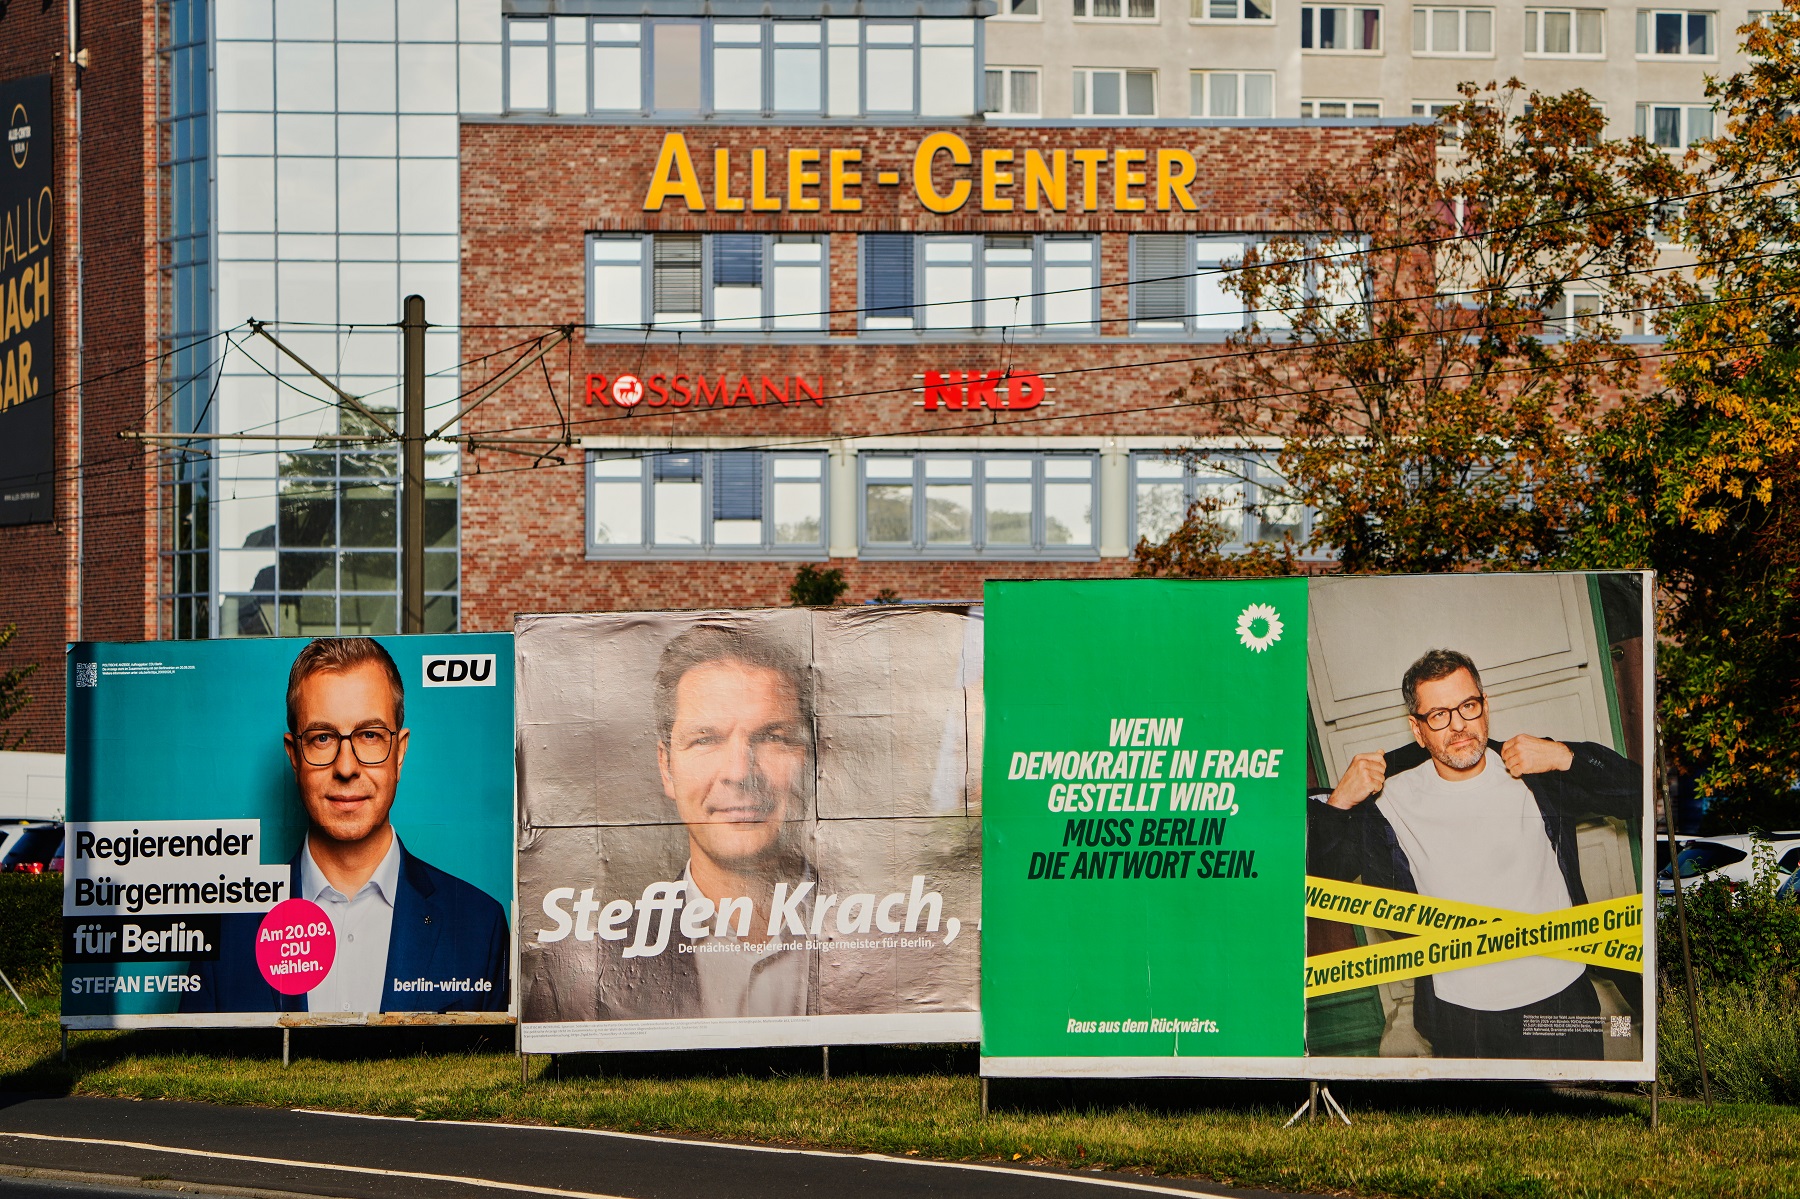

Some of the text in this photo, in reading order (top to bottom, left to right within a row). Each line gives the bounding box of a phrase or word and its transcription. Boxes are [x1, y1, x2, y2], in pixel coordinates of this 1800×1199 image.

[0, 186, 53, 273] ALLO
[0, 340, 39, 413] AR.
[924, 370, 1046, 412] NKD
[426, 659, 492, 682] CDU
[1108, 718, 1184, 747] WENN
[1008, 749, 1284, 780] DEMOKRATIE IN FRAGE
[1048, 782, 1240, 816] GESTELLT WIRD,
[76, 828, 254, 866] Regierender
[1063, 818, 1226, 847] MUSS BERLIN
[1027, 850, 1258, 880] DIE ANTWORT SEIN.
[74, 874, 284, 912] Bürgermeister
[1306, 886, 1372, 916] Werner
[1372, 898, 1417, 922] Graf
[537, 875, 961, 958] Steffen Krach,
[72, 922, 212, 954] für Berlin.
[260, 922, 330, 942] Am 20.09.
[678, 938, 934, 954] Der nächste Regierende Bürgermeister für Berlin.
[280, 940, 310, 958] CDU
[1305, 950, 1424, 988] Zweitstimme
[1428, 938, 1472, 964] Grün
[1476, 916, 1600, 956] Zweitstimme
[270, 959, 324, 976] wählen.
[71, 974, 201, 994] STEFAN EVERS
[394, 978, 492, 992] berlin-wird.de
[1066, 1018, 1220, 1033] Raus aus dem Rückwärts.
